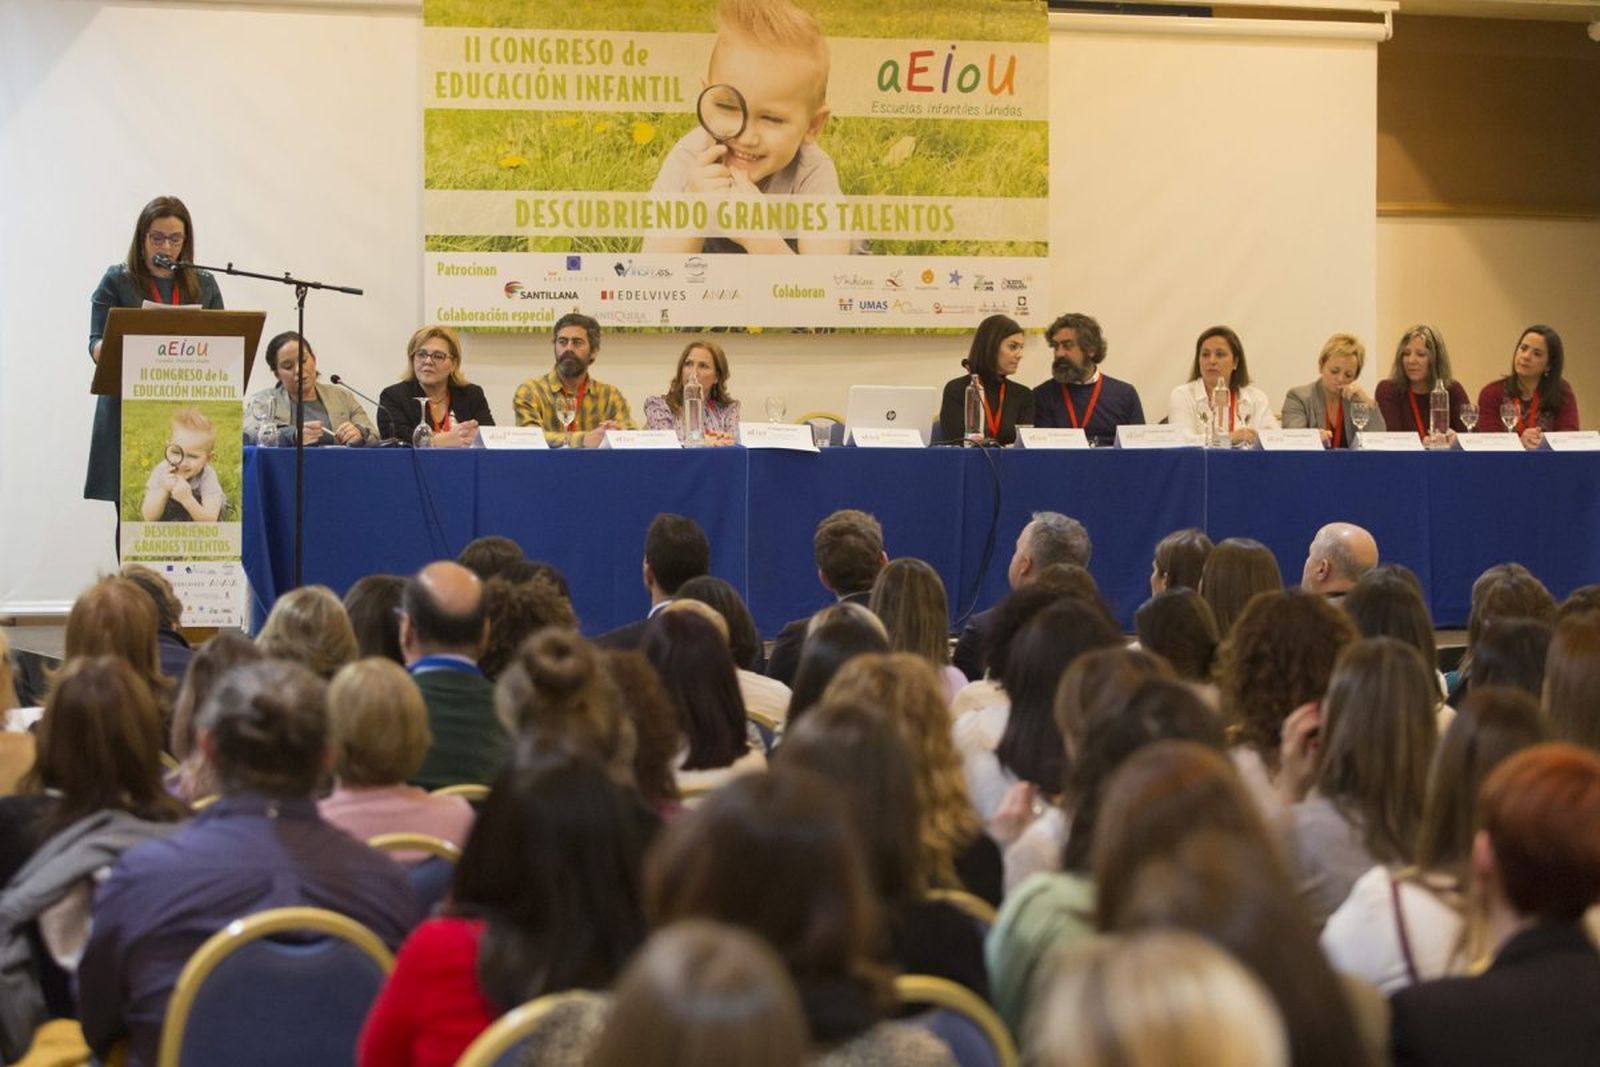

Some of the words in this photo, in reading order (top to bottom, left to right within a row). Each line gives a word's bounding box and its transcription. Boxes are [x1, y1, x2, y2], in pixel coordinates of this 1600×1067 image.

[464, 36, 481, 63] II
[490, 36, 614, 66] CONGRESO
[622, 40, 649, 67] de
[435, 68, 568, 101] EDUCACIÓN
[575, 74, 684, 103] INFANTIL
[871, 101, 923, 114] Escuelas
[984, 104, 1023, 117] Unidas
[514, 198, 708, 230] DESCUBRIENDO
[716, 200, 828, 231] GRANDES
[836, 202, 956, 233] TALENTOS
[436, 261, 497, 277] Patrocinan
[520, 291, 579, 300] SANTILLANA
[617, 290, 687, 301] EDELVIVES
[772, 284, 826, 299] Colaboran
[859, 300, 888, 310] UMAS
[437, 307, 508, 322] Colaboración
[511, 307, 555, 324] especial
[140, 367, 148, 380] II
[150, 368, 203, 381] CONGRESO
[204, 369, 217, 380] de
[219, 369, 229, 381] la
[133, 382, 189, 397] EDUCACIÓN
[191, 385, 237, 398] INFANTIL
[144, 525, 219, 538] DESCUBRIENDO
[134, 540, 180, 553] GRANDES
[183, 540, 230, 553] TALENTOS
